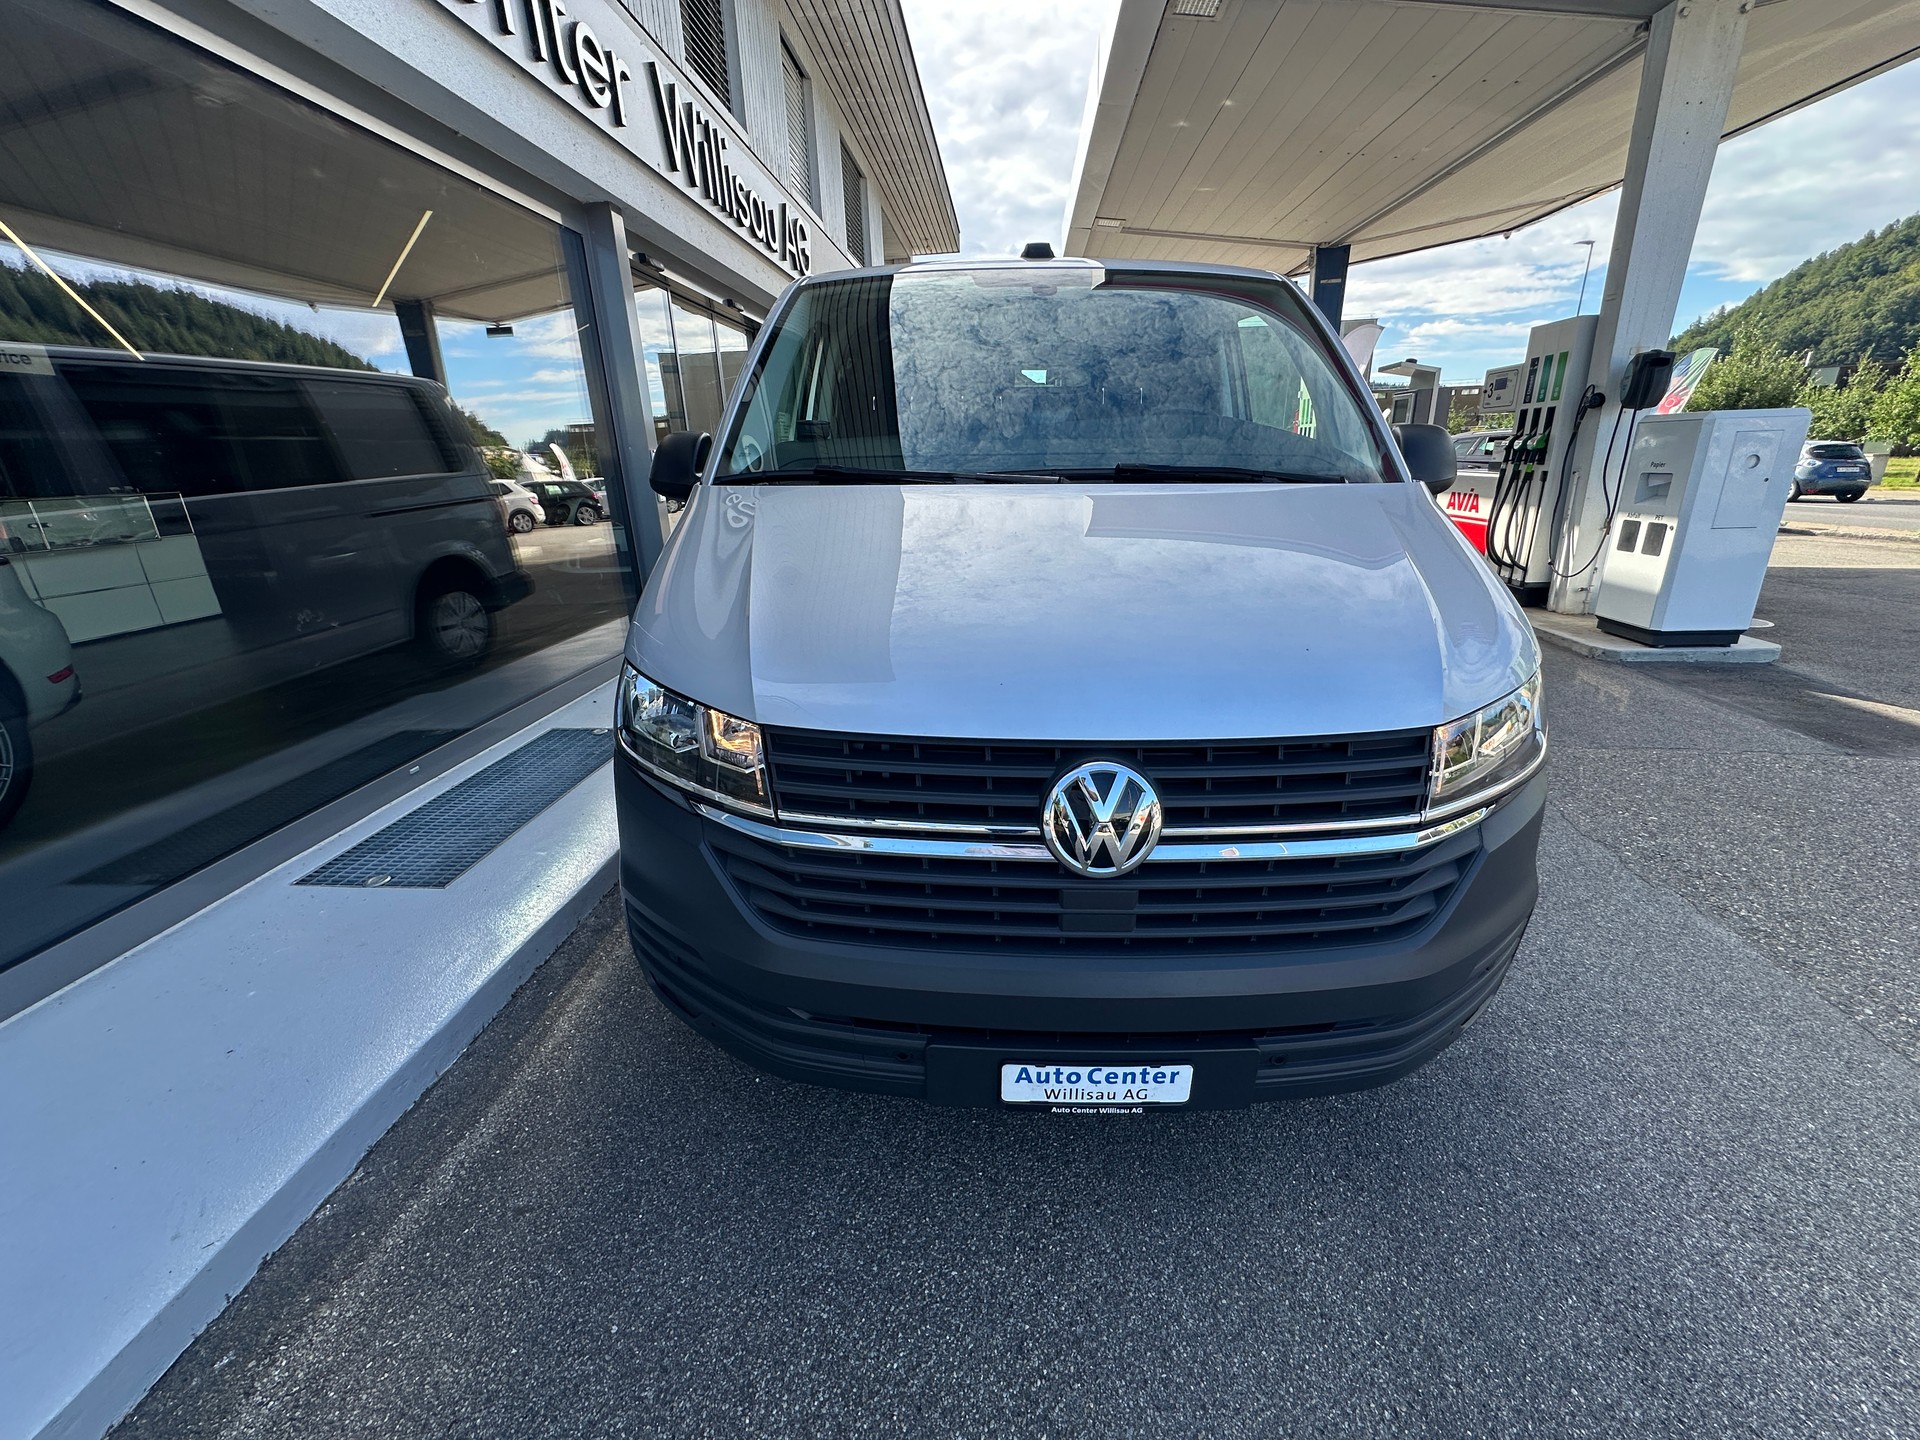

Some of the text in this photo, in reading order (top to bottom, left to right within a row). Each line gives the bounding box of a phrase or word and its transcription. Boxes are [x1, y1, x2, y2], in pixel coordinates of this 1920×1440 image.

[643, 61, 778, 253] Willisau
[778, 202, 812, 276] AG
[0, 349, 32, 365] ice
[1487, 382, 1494, 398] 3
[1650, 461, 1667, 469] Papier
[1446, 488, 1479, 513] AVIA
[1014, 1066, 1180, 1084] Auto Center
[1044, 1088, 1149, 1100] Willisau AG
[1051, 1106, 1143, 1114] Auto Center Willisau AG
